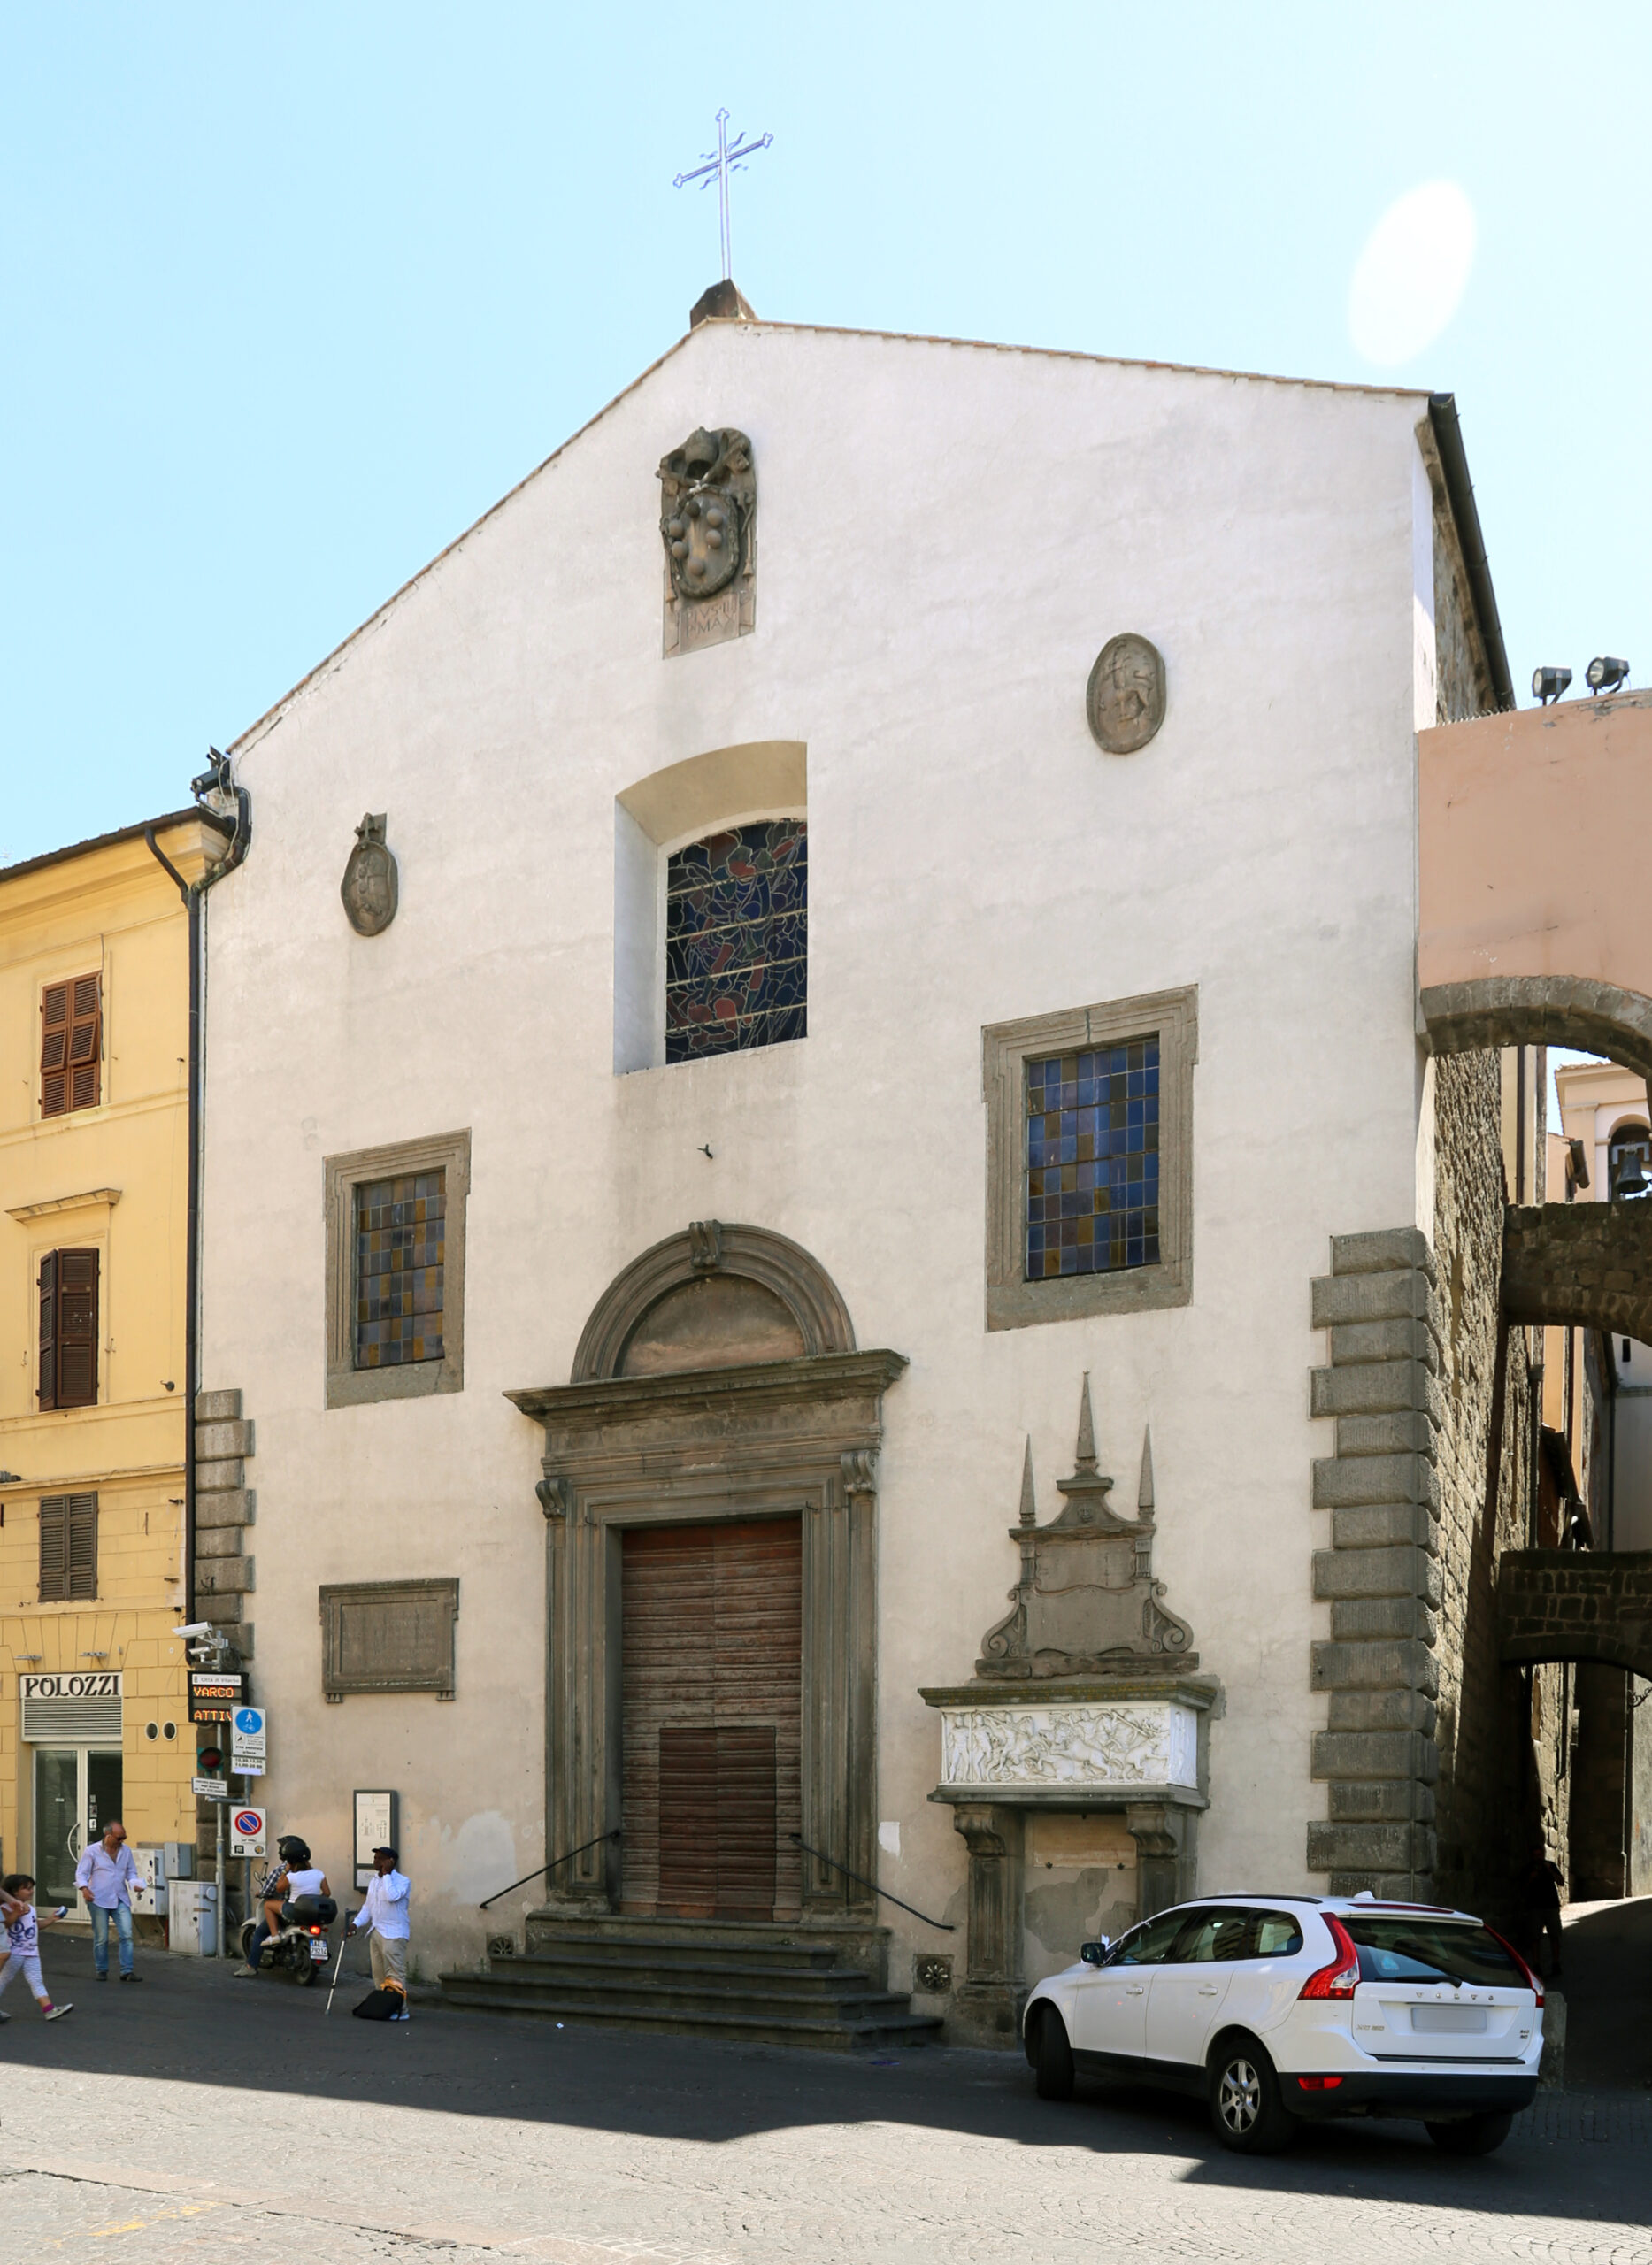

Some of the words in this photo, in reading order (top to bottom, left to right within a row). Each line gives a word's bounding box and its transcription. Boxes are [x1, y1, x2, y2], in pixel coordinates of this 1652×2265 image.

[24, 1675, 119, 1697] POLOZZI
[193, 1686, 234, 1697] VARCO
[1416, 1992, 1494, 2001] VOLVO
